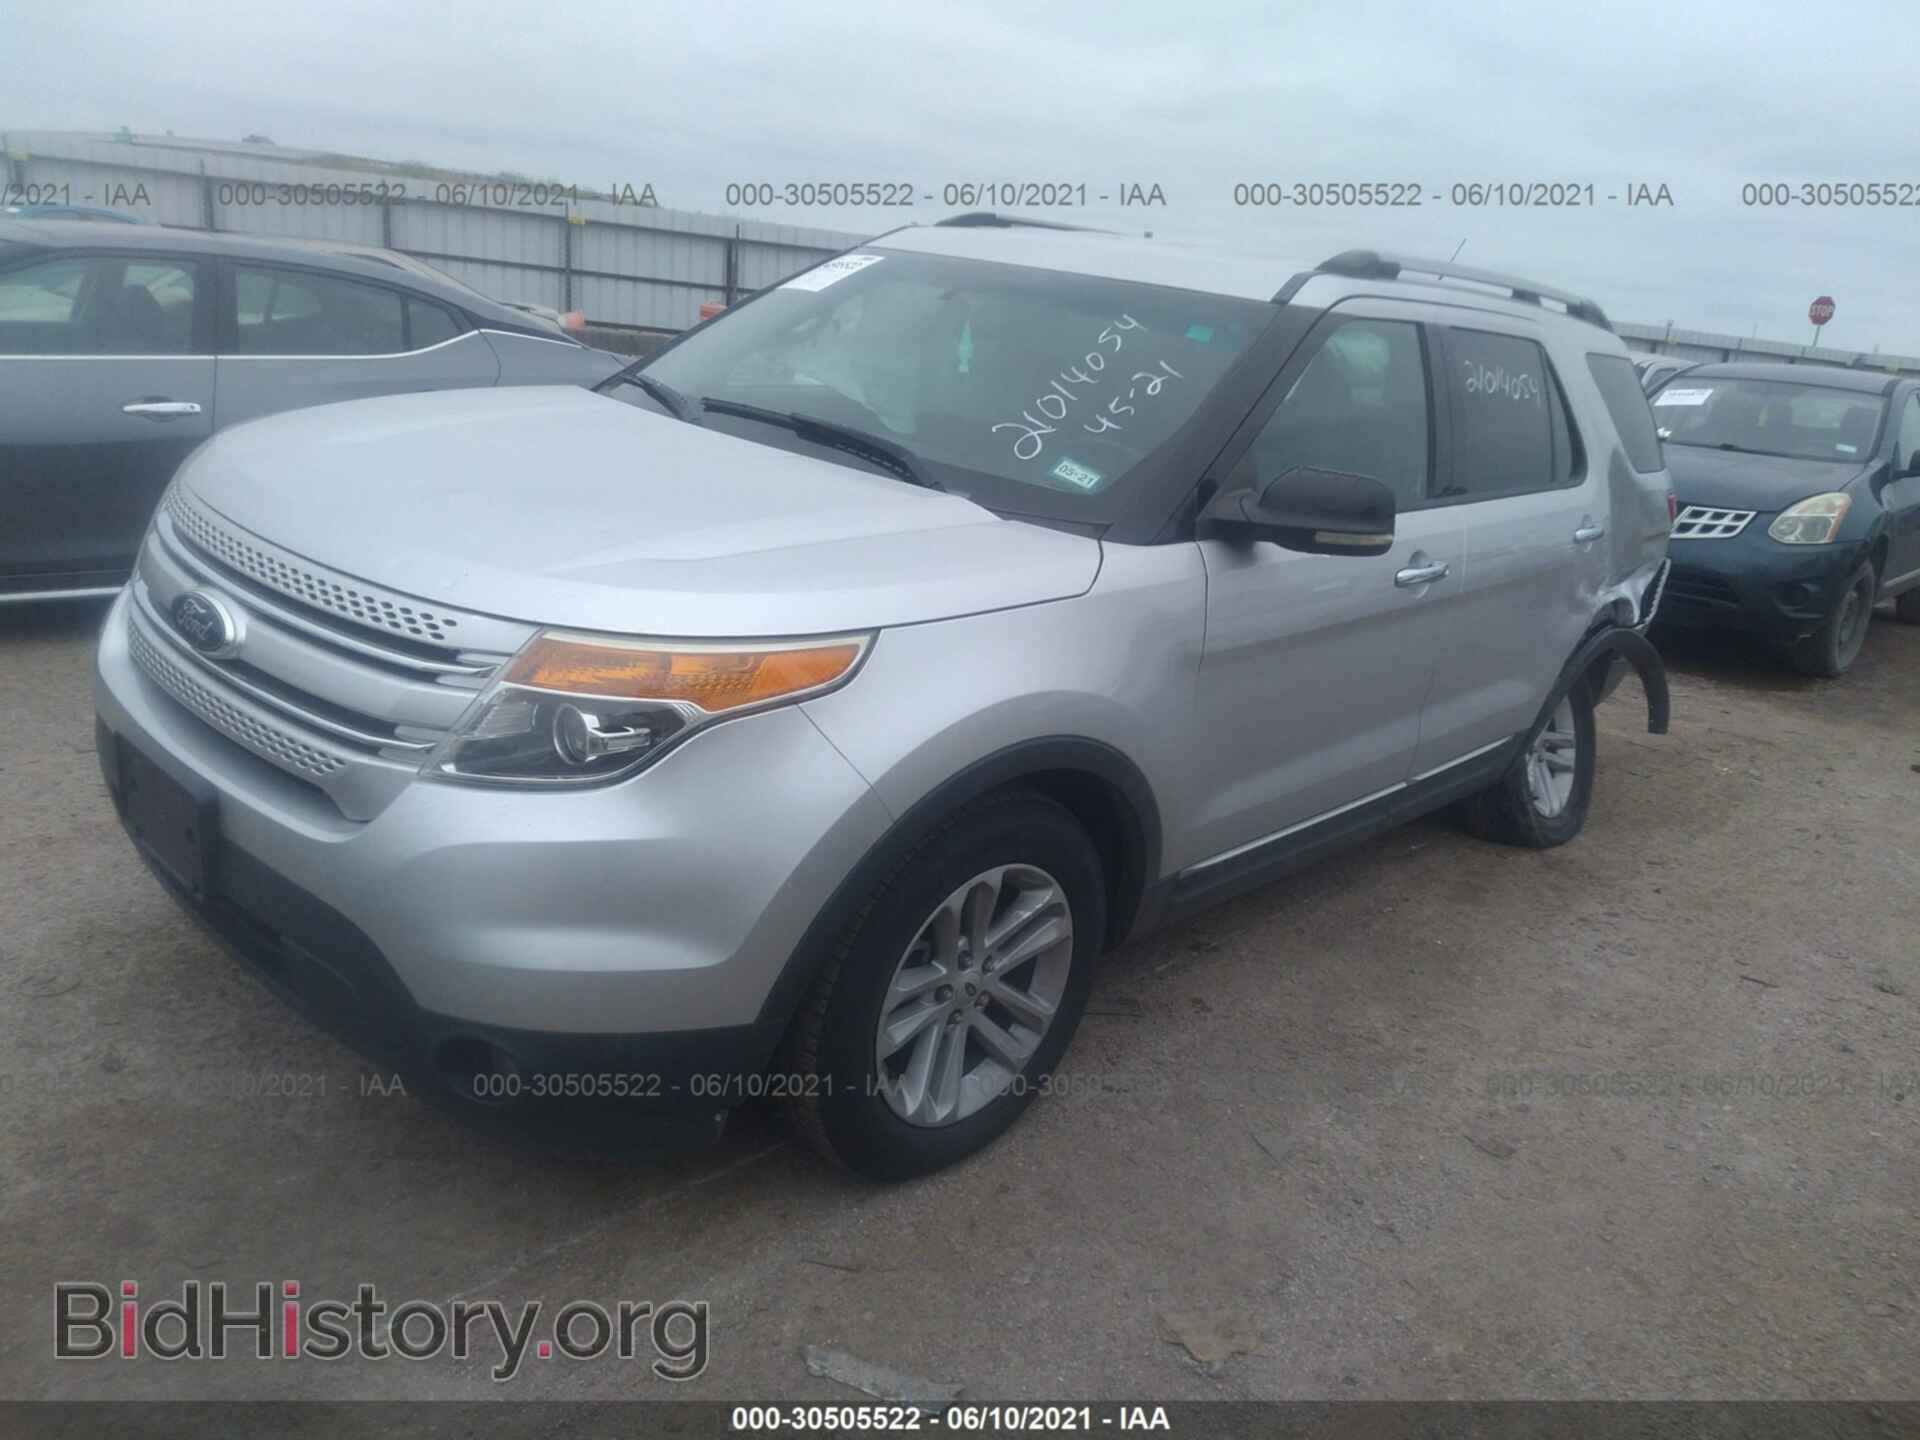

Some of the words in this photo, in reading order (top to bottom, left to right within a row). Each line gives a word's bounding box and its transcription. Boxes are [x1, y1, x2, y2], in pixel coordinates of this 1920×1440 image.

[1809, 303, 1833, 317] STOP
[991, 314, 1147, 460] 21014054
[1083, 360, 1183, 433] 45-21
[1059, 464, 1095, 484] 05-21
